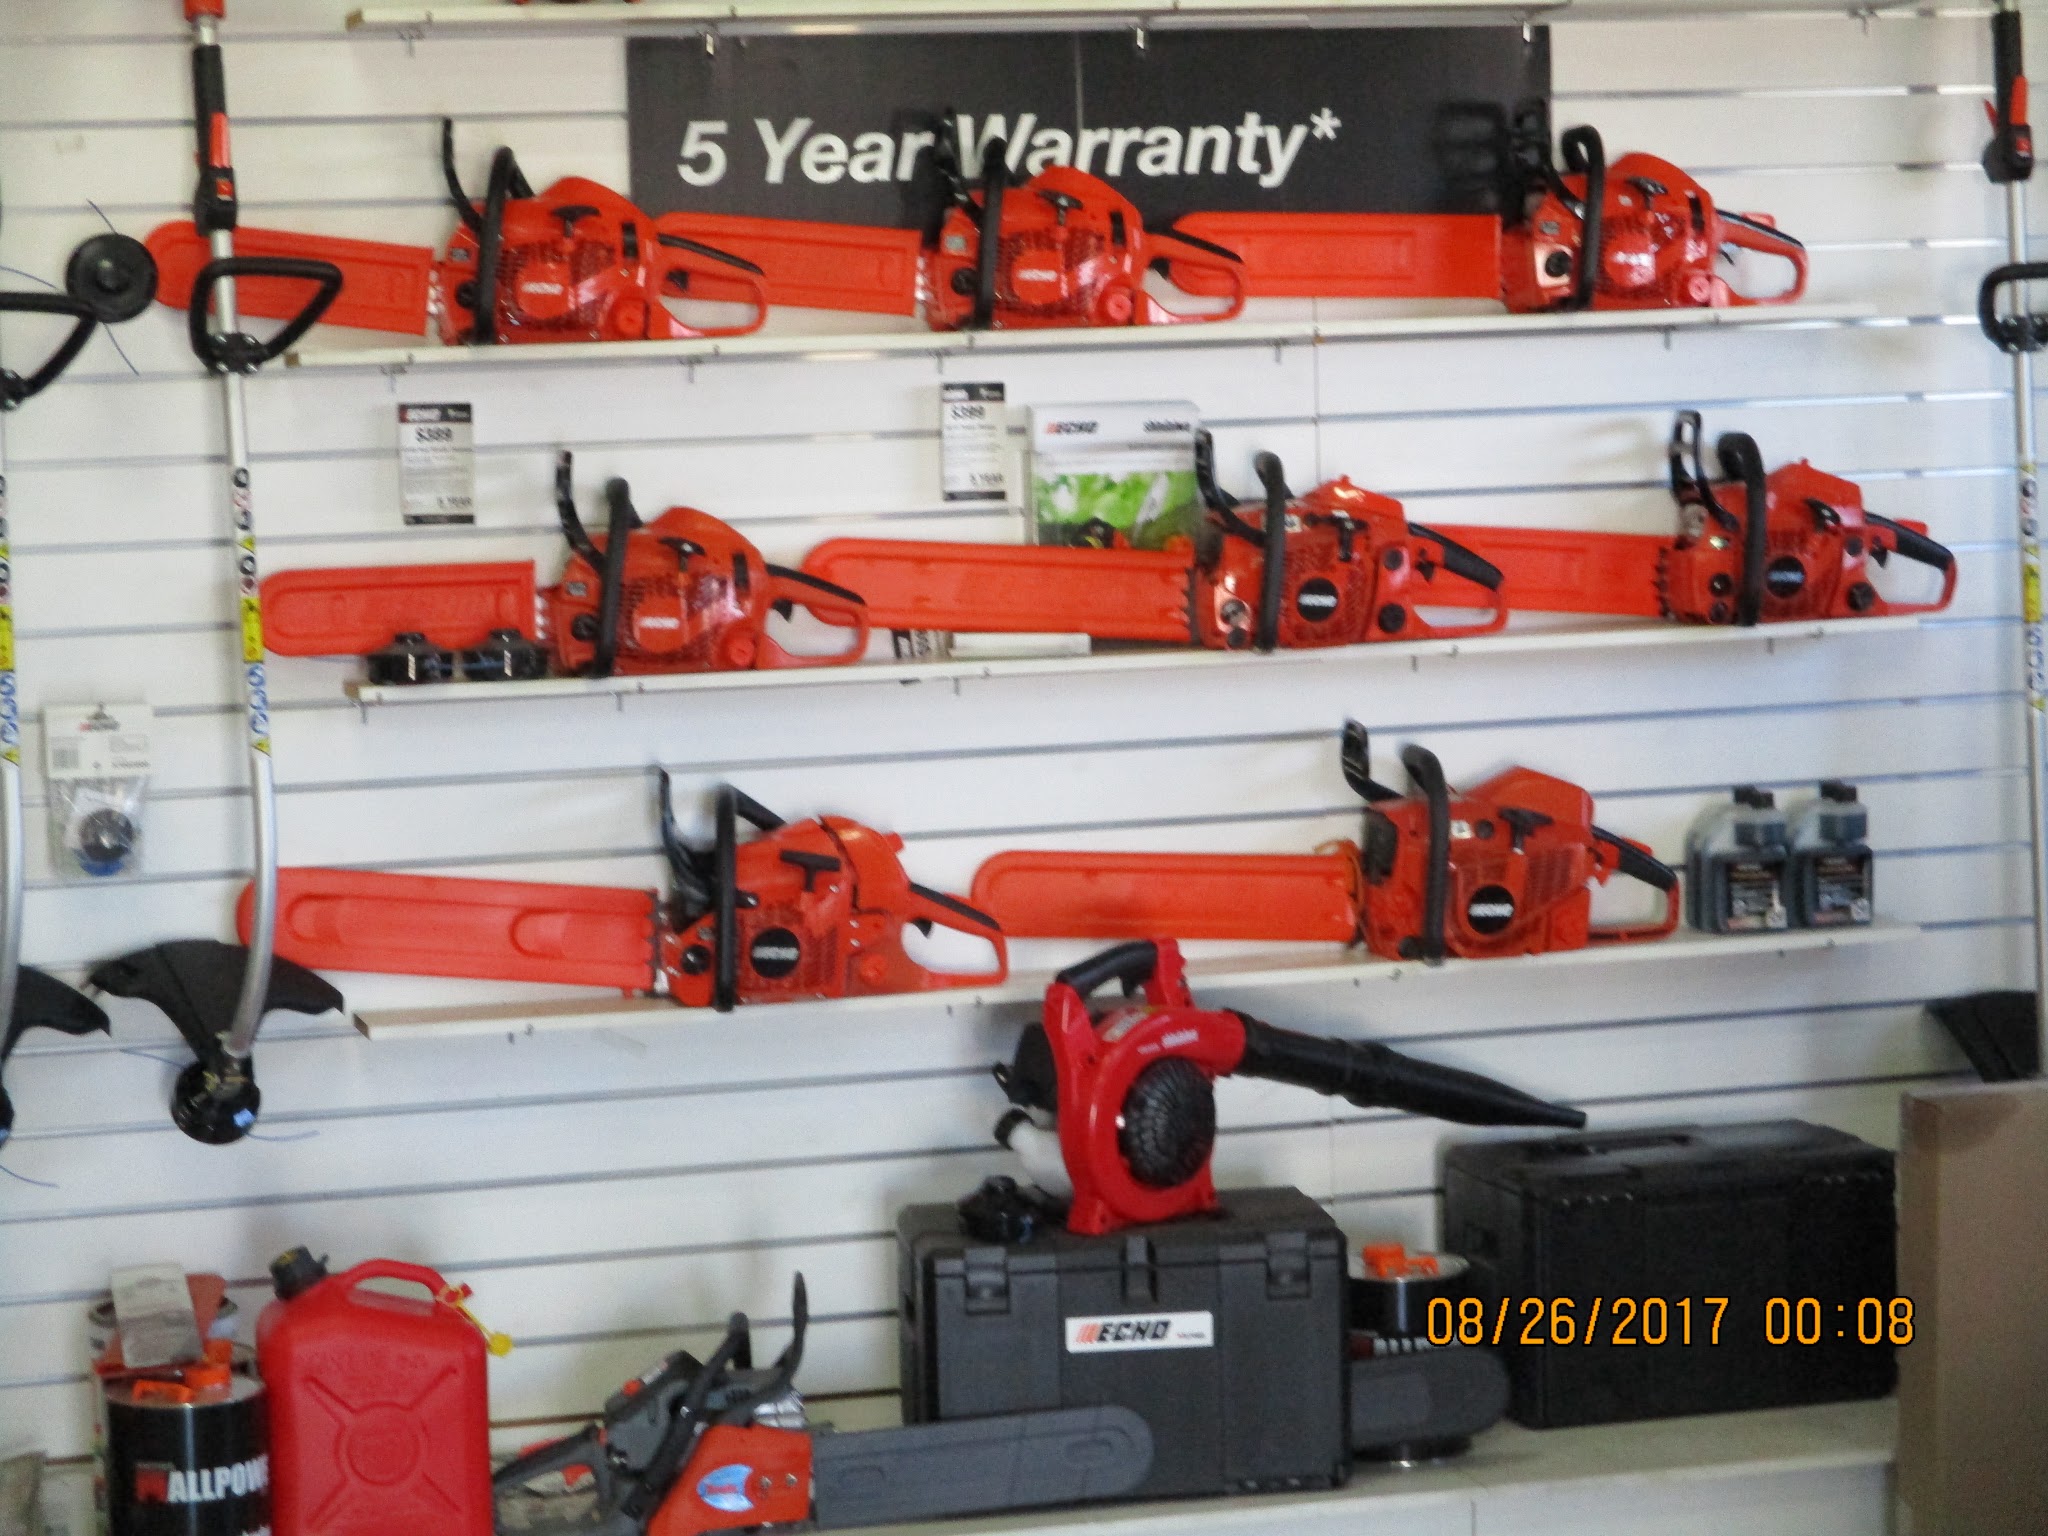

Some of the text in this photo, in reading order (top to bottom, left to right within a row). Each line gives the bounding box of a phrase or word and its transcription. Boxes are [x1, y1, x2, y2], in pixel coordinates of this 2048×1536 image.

[677, 120, 728, 187] 5
[754, 117, 935, 185] Year
[1098, 1318, 1172, 1342] ECHO
